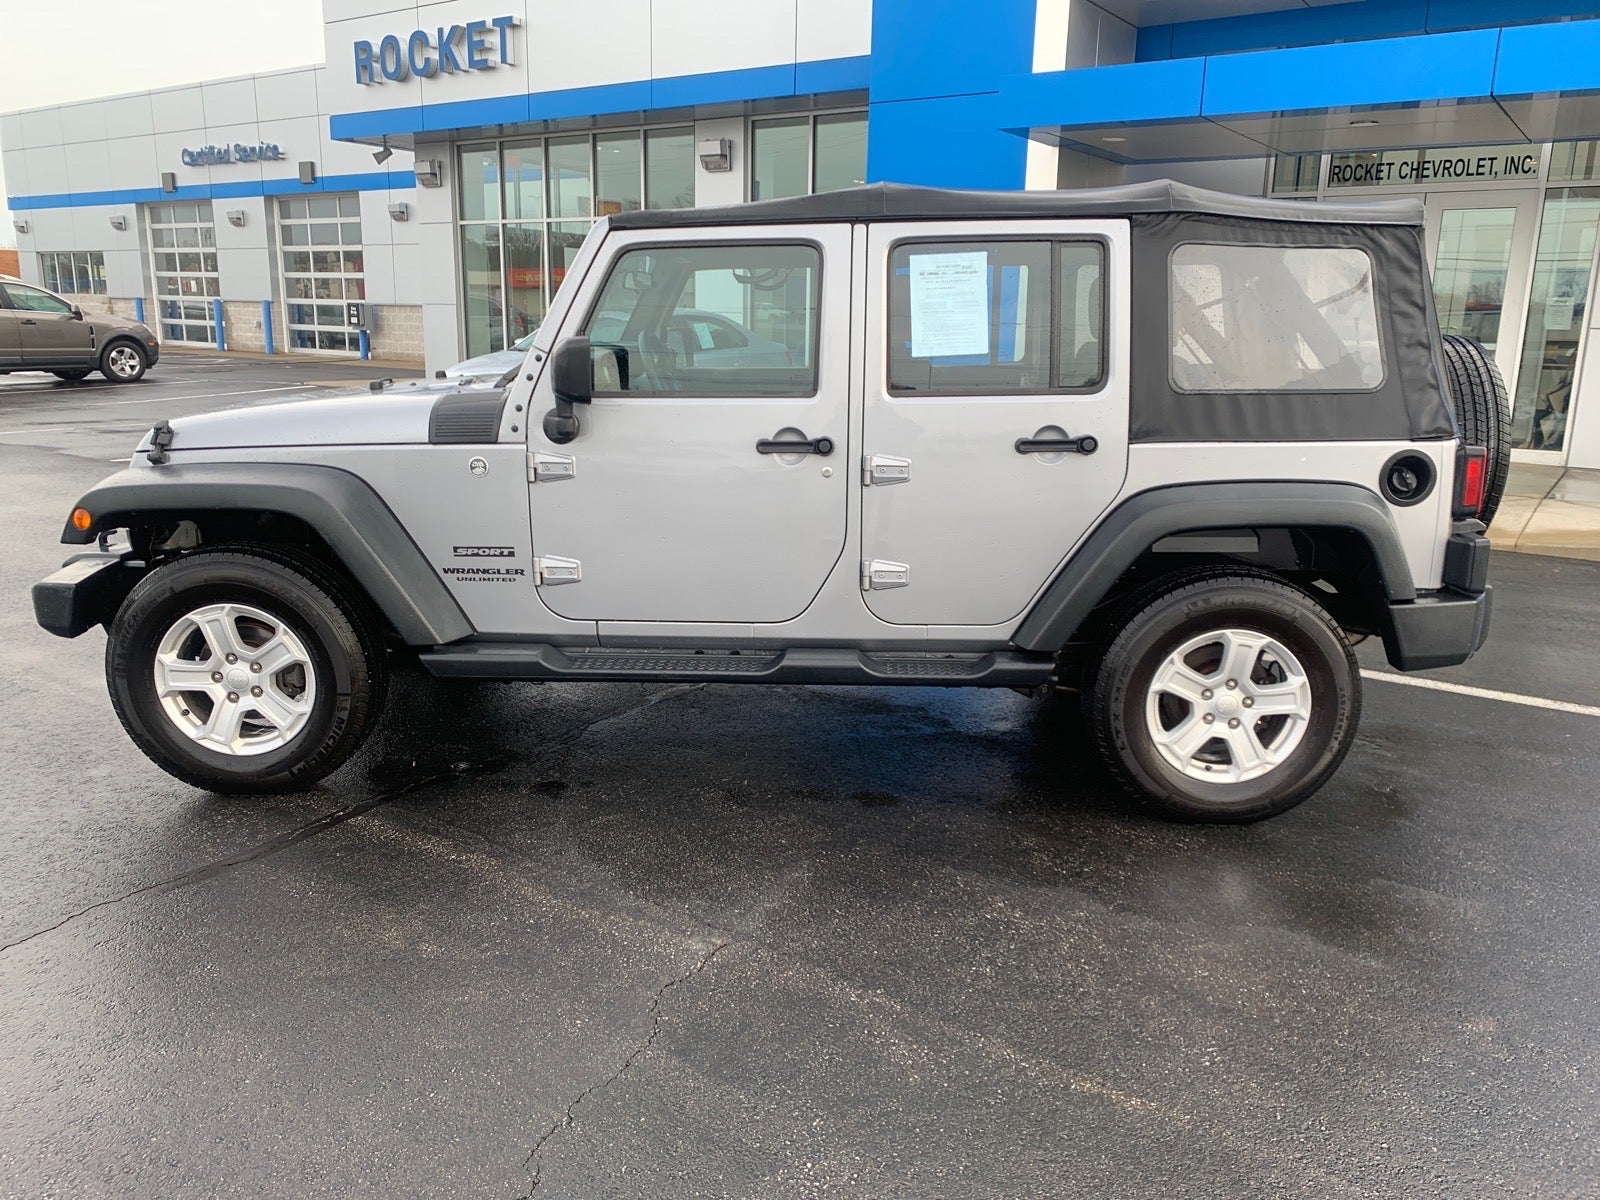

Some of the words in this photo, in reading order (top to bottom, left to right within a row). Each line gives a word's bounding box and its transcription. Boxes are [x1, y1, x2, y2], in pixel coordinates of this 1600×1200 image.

[353, 15, 519, 86] ROCKET
[181, 143, 232, 167] Certified
[233, 140, 283, 163] Service
[1331, 161, 1395, 183] ROCKET
[1398, 156, 1499, 180] CHEVROLET,
[1503, 154, 1538, 176] INC.
[454, 547, 514, 557] SPORT
[442, 567, 526, 576] WRANGLER
